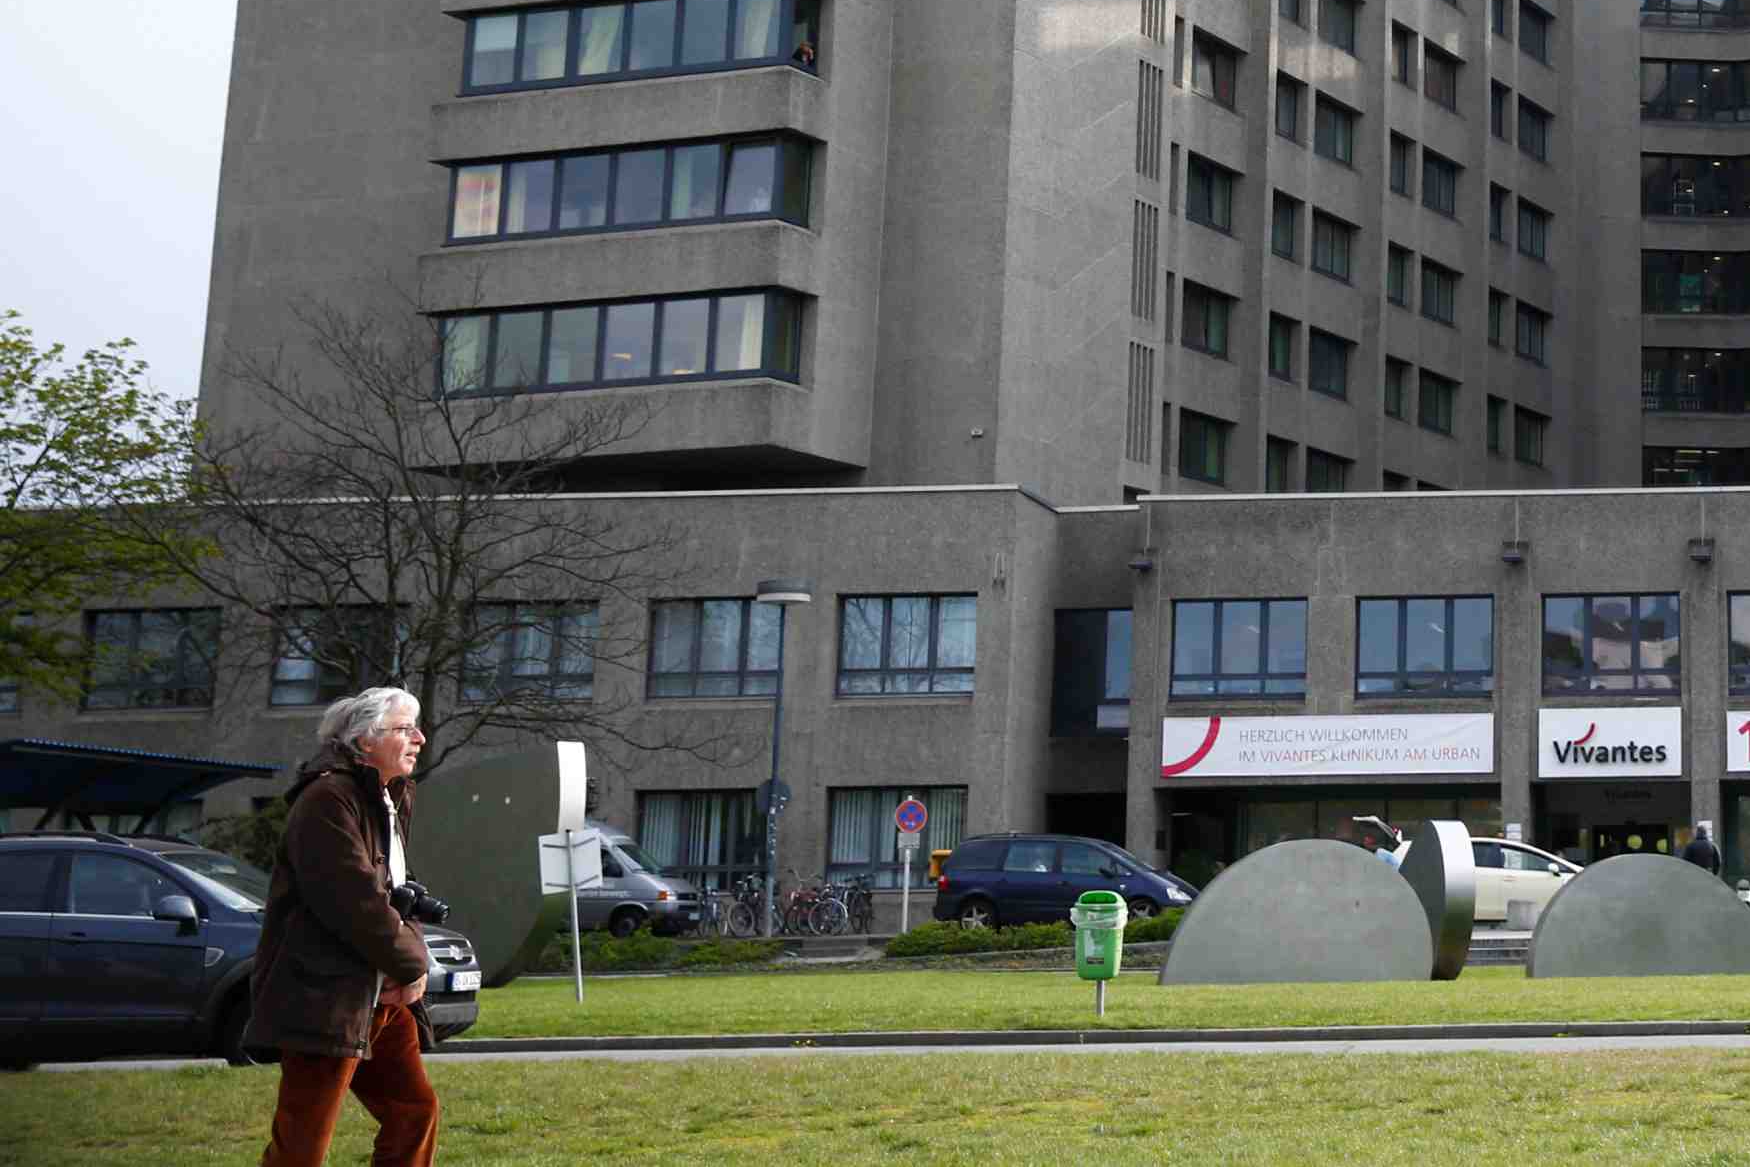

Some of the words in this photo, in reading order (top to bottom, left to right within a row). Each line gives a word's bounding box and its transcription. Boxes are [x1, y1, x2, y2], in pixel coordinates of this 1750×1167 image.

[1240, 729, 1304, 743] HERZLICH
[1309, 728, 1408, 742] WILLKOMMEN
[1239, 750, 1256, 763] IM
[1260, 749, 1326, 763] VIVANTES
[1331, 748, 1399, 762] KLINIKUM
[1402, 748, 1427, 761] AM
[1431, 746, 1480, 761] URBAN
[1553, 740, 1667, 764] Vivantes
